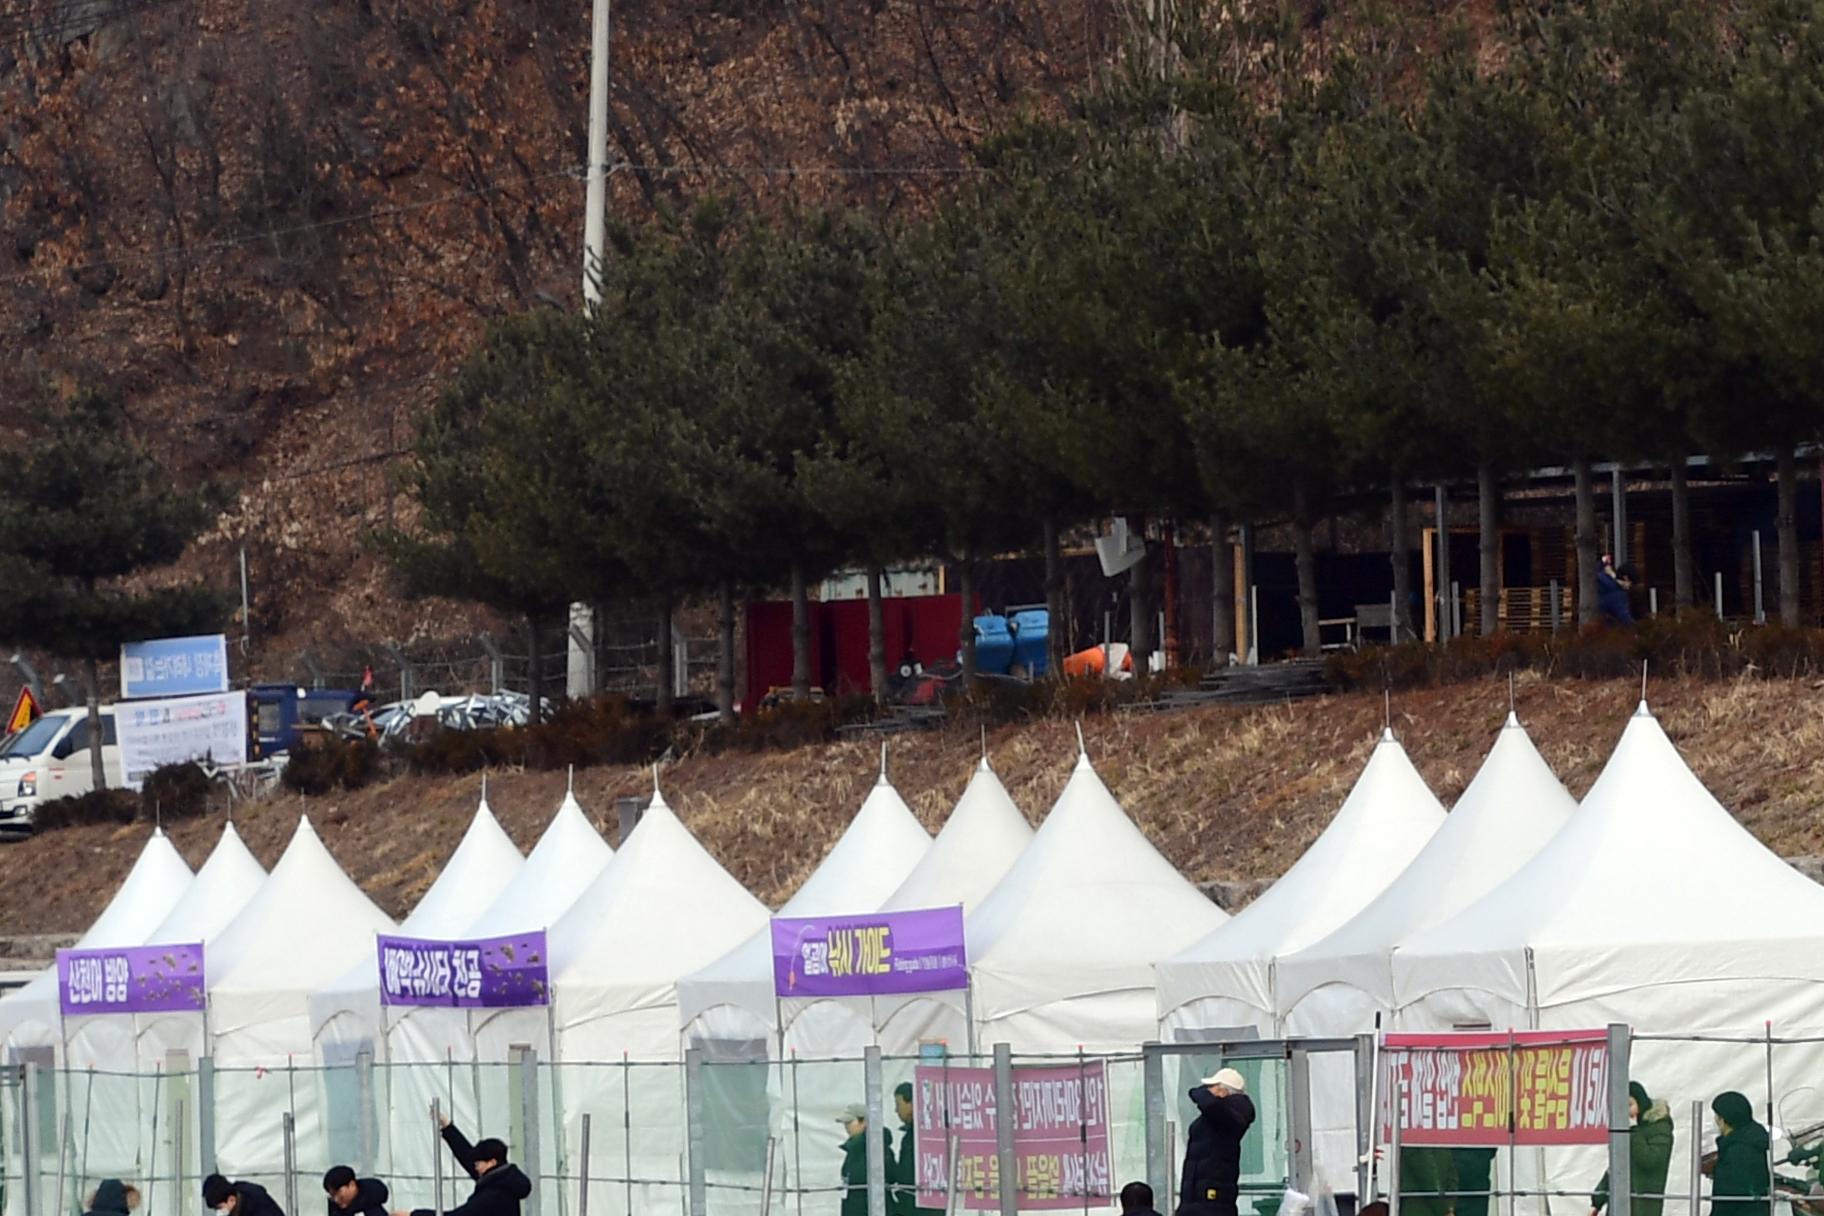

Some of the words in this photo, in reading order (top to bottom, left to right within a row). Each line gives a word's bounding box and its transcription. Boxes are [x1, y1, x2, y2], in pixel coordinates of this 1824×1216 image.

[828, 929, 853, 977] 낚시
[854, 927, 892, 976] 가이드
[69, 957, 103, 1004] 산천어
